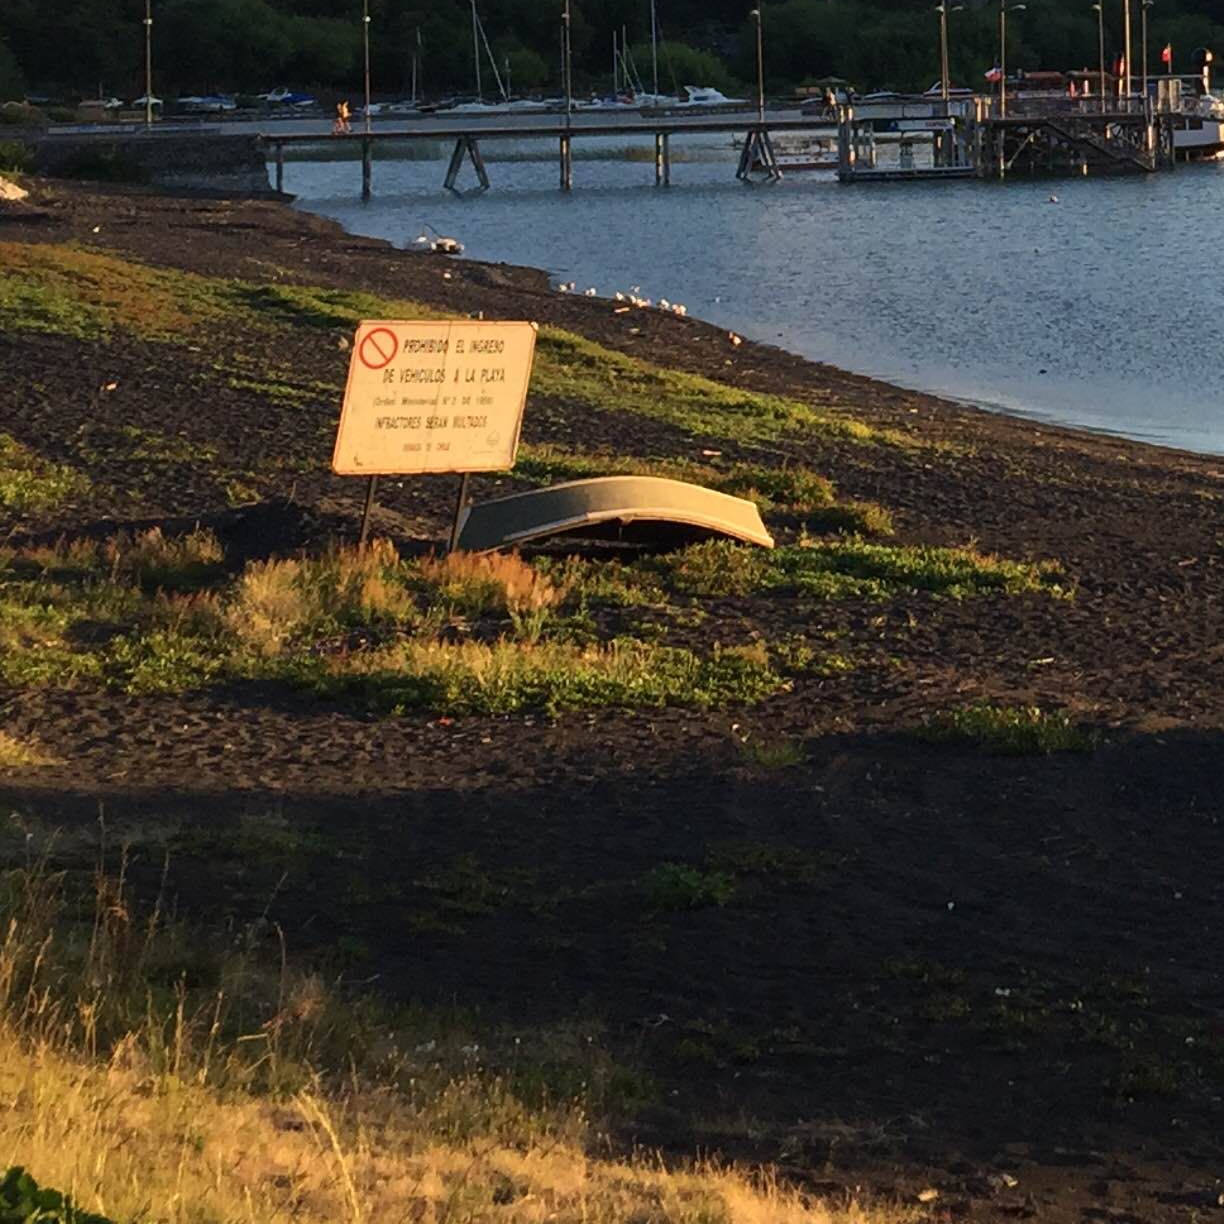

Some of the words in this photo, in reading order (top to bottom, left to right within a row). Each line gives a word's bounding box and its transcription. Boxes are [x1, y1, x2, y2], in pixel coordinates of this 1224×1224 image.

[455, 339, 465, 353] EL
[382, 368, 395, 384] DE
[465, 368, 476, 383] LA
[480, 368, 505, 383] PLAYA
